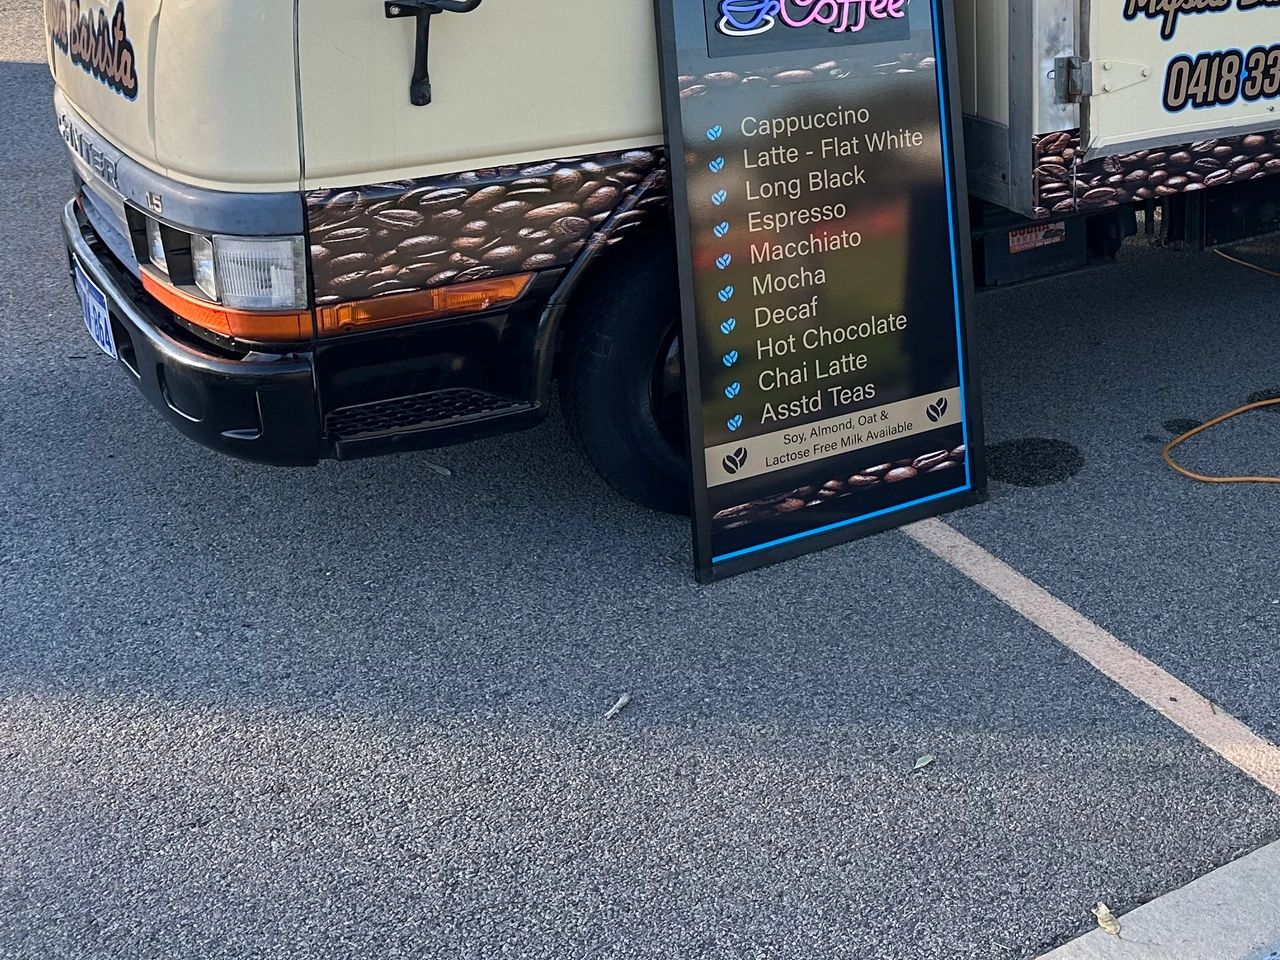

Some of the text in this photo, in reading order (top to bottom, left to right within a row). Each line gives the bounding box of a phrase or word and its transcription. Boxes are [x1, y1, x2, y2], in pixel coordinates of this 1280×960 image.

[1165, 50, 1243, 111] 0418
[740, 105, 870, 138] Cappuccino
[743, 144, 799, 169] Latte
[821, 135, 859, 159] Flat
[865, 128, 923, 153] White
[746, 166, 866, 200] Long Black
[748, 201, 847, 233] Espresso
[1221, 199, 1255, 208] Skittles
[750, 230, 862, 264] Macchiato
[752, 267, 826, 296] Mocha
[754, 296, 819, 328] Decaf
[756, 312, 908, 360] Hot Chocolate
[758, 352, 868, 391] Chai Latte
[760, 382, 876, 424] Asstd Teas
[765, 420, 913, 468] Lactose Free Milk Available
[783, 409, 889, 446] Soy, Almond, Oat &
